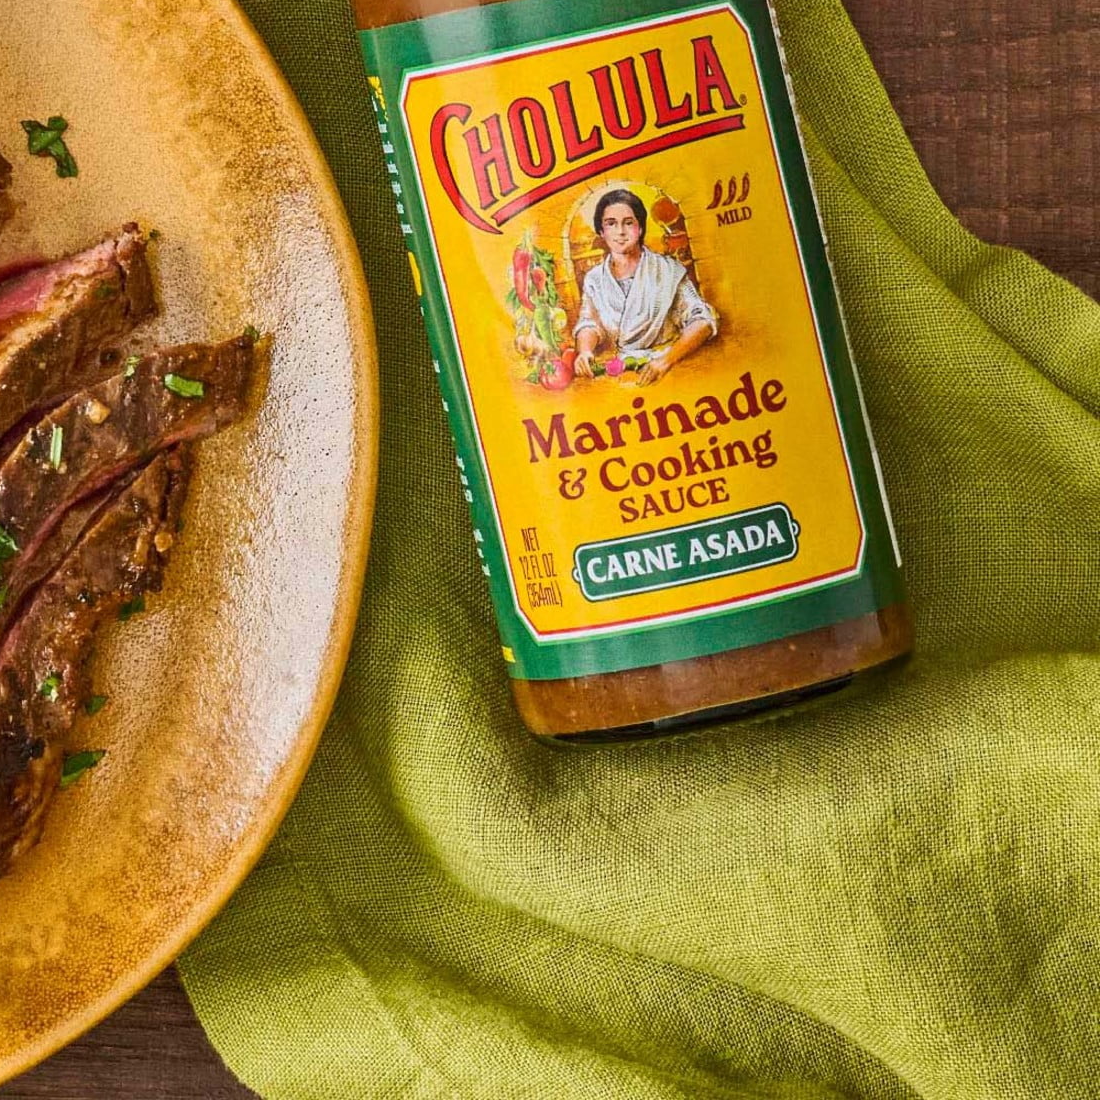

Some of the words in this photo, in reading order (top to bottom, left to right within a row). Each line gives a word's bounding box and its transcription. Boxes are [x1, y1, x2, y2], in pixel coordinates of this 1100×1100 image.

[430, 35, 742, 234] CHOLULA
[716, 206, 752, 227] MILD
[522, 371, 787, 463] Marinade
[558, 467, 587, 500] &
[600, 429, 777, 493] Cooking
[619, 477, 730, 523] SAUCE
[519, 556, 532, 580] 12
[530, 554, 543, 579] FL
[542, 553, 557, 577] OZ
[521, 527, 540, 552] NET
[586, 543, 682, 584] CARNE
[689, 520, 786, 565] ASADA
